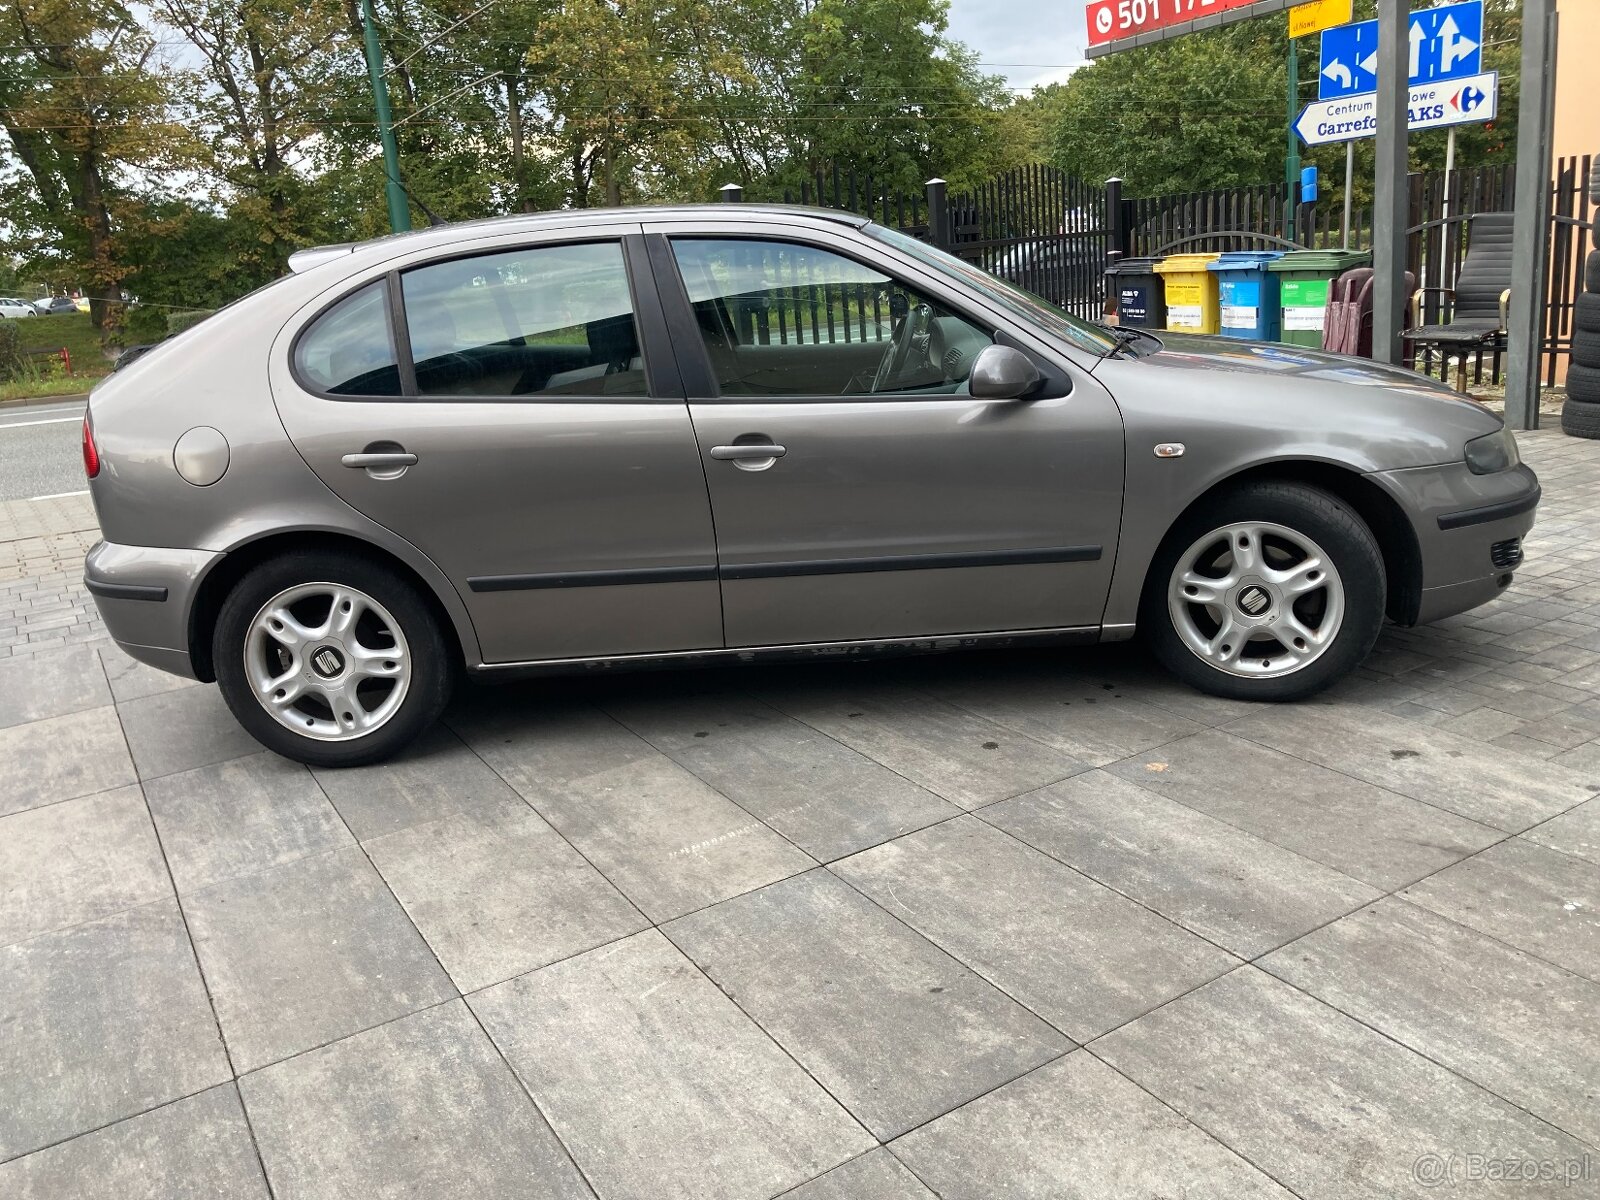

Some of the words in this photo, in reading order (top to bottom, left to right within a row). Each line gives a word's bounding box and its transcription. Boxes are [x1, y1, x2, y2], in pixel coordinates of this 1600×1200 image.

[1118, 0, 1160, 29] 501
[1326, 102, 1373, 117] Centrum
[1407, 91, 1436, 103] lowe
[1317, 115, 1377, 137] Carrefo
